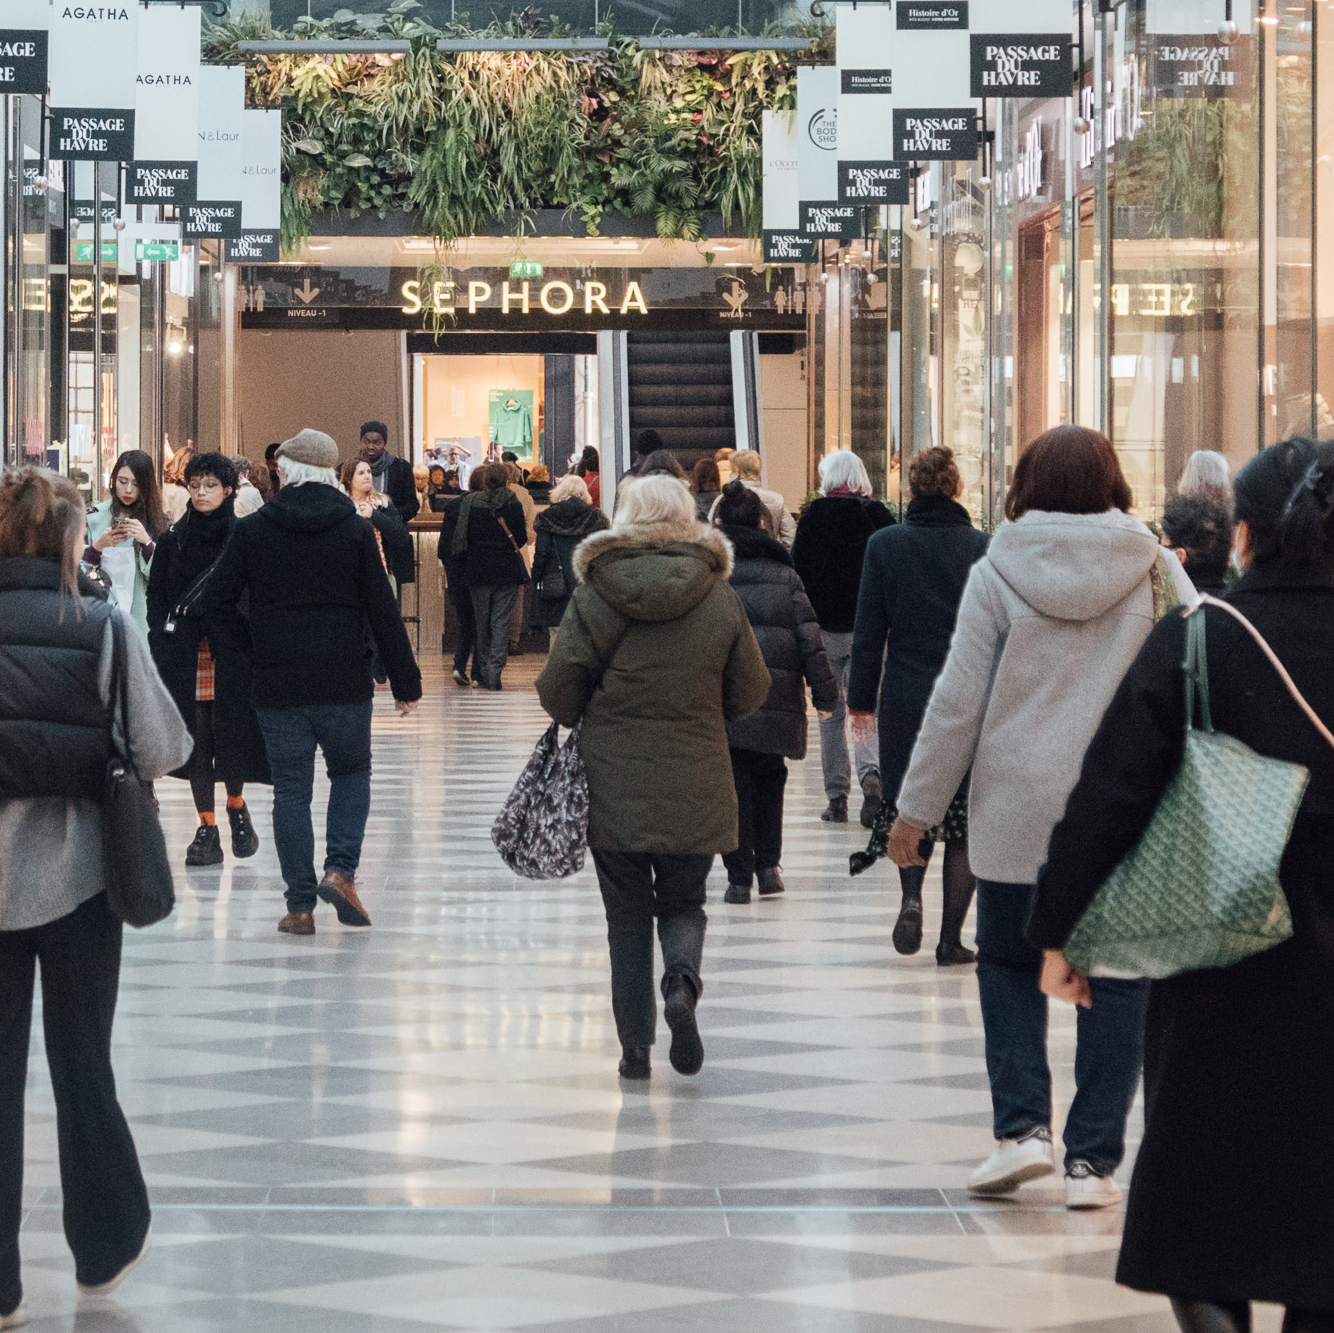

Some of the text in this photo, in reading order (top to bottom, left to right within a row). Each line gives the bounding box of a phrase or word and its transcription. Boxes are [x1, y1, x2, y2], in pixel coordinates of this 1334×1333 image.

[62, 7, 129, 20] AGATHA
[909, 8, 959, 17] Histoire d'Or
[987, 46, 1060, 61] PASSAGE
[998, 58, 1020, 73] DU
[136, 74, 192, 86] AGATHA
[983, 71, 1040, 85] HAVRE
[64, 118, 124, 131] PASSAGE
[906, 118, 966, 131] PASSAGE
[73, 129, 91, 141] DU
[915, 129, 934, 141] DU
[60, 139, 107, 151] HAVRE
[904, 139, 950, 151] HAVRE
[769, 160, 798, 168] L'OCCIT
[137, 169, 188, 179] PASSAGE
[849, 169, 900, 179] PASSAGE
[145, 178, 161, 188] DU
[857, 178, 873, 188] DU
[134, 186, 174, 196] HAVRE
[846, 186, 886, 196] HAVRE
[189, 208, 234, 217] PASSAGE
[809, 208, 853, 217] PASSAGE
[196, 216, 210, 225] DU
[815, 216, 829, 225] DU
[187, 223, 222, 232] HAVRE
[807, 223, 841, 232] HAVRE
[233, 235, 272, 243] ASSAGE
[231, 248, 261, 256] HAVRE
[401, 280, 647, 315] SEPHORA
[288, 309, 317, 317] NIVEAU
